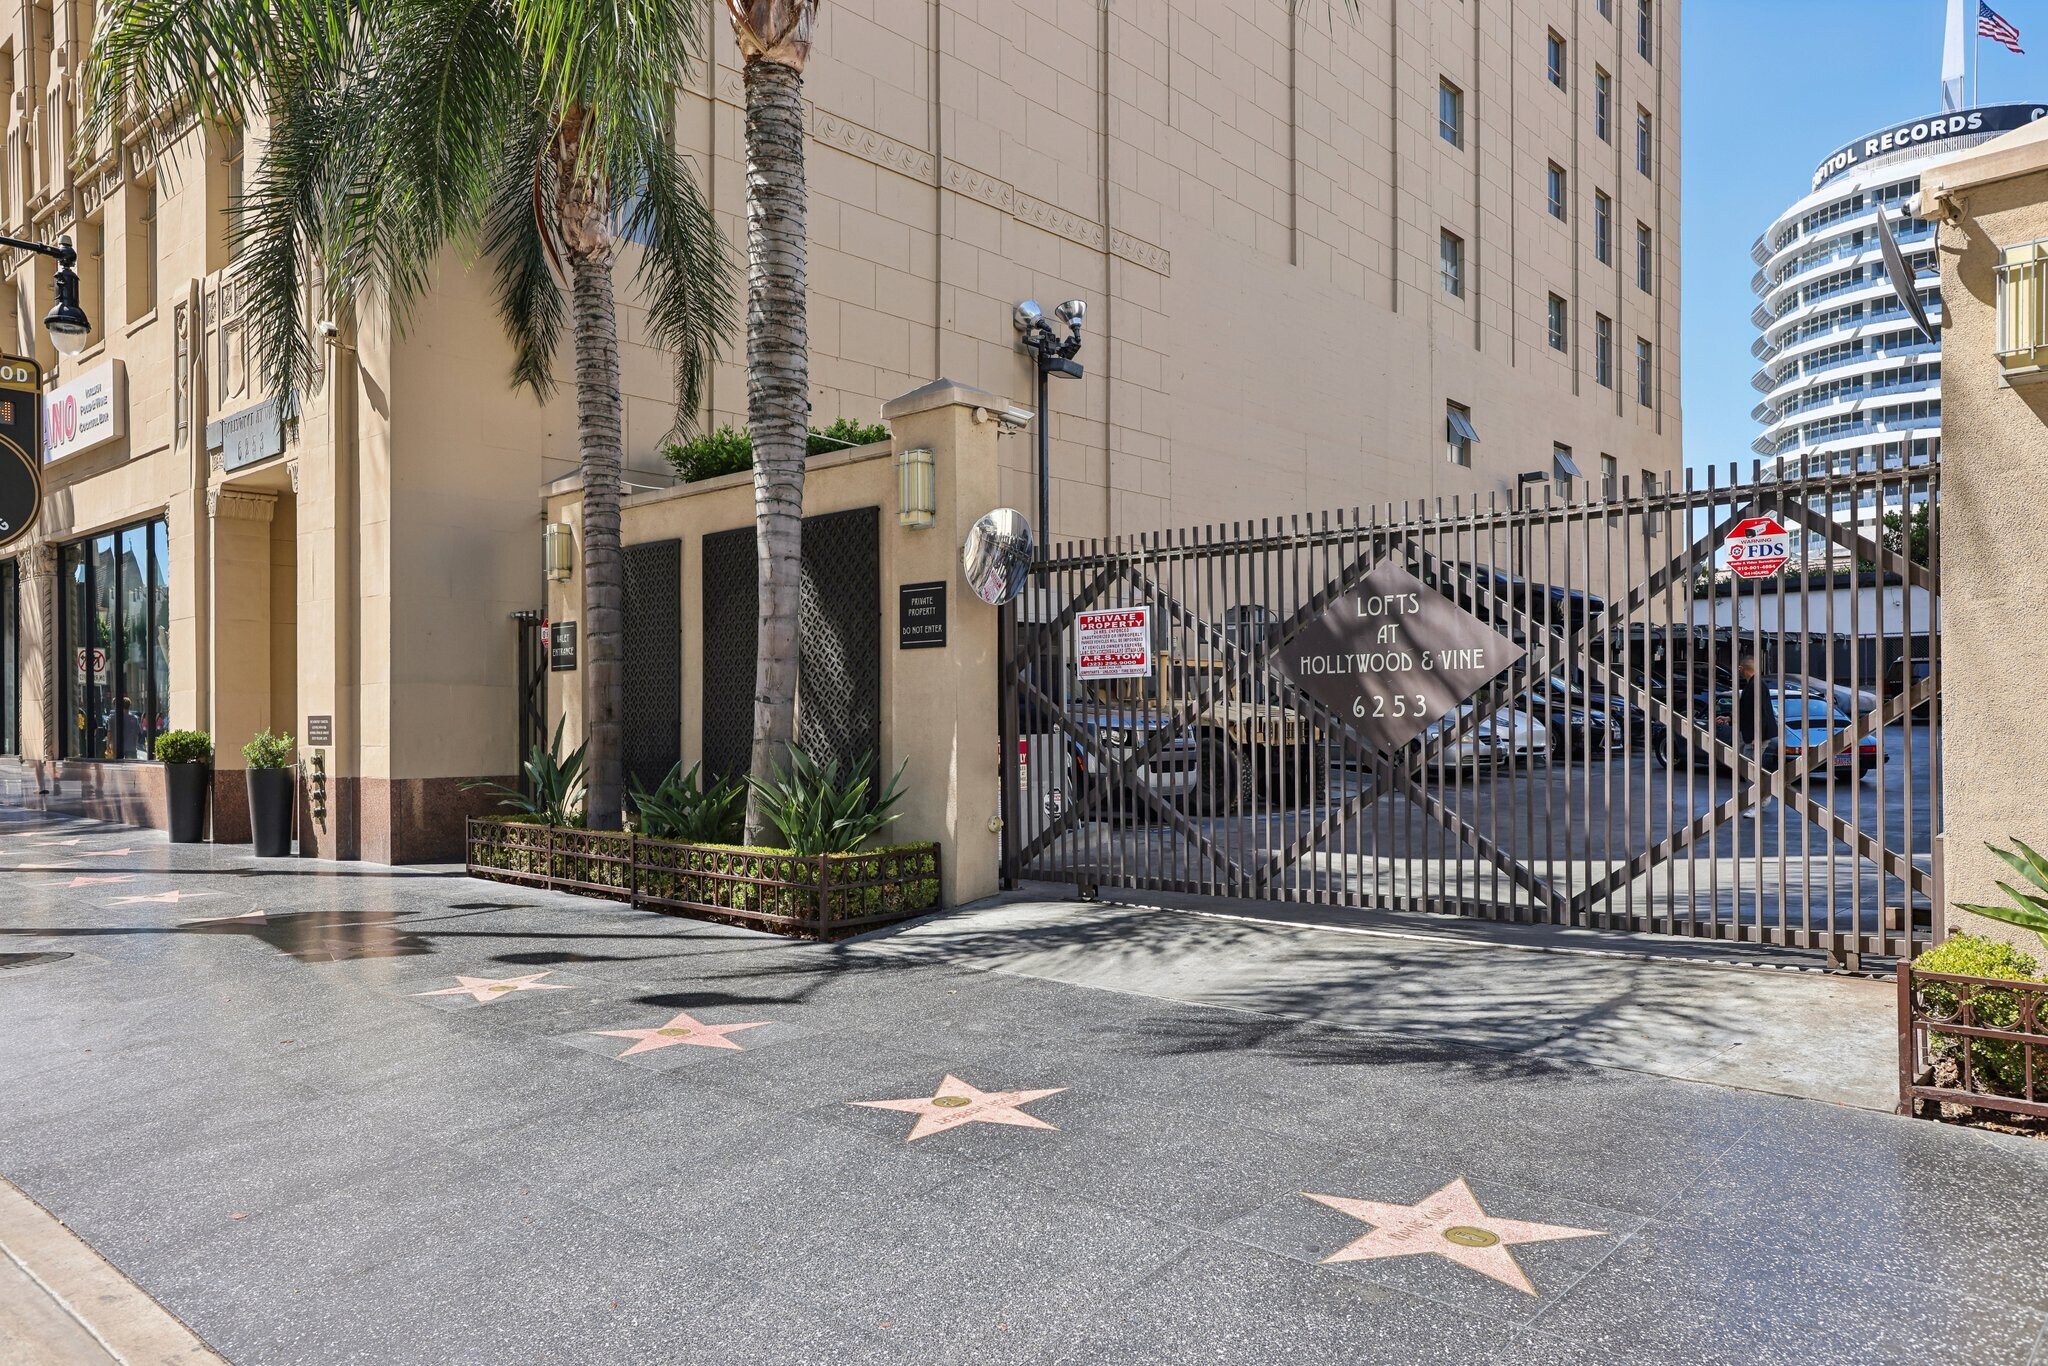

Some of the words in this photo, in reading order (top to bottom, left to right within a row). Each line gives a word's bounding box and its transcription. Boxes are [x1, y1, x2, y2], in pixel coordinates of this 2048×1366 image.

[1865, 112, 1983, 157] RECORDS
[1748, 543, 1784, 558] FDS
[911, 596, 933, 606] PRIVATE
[1357, 593, 1420, 617] LOFTS
[908, 607, 936, 617] PROPERTY
[1087, 613, 1136, 623] PRIVATE
[902, 626, 911, 635] DO
[912, 625, 923, 634] NOT
[925, 624, 943, 633] ENTER
[1081, 619, 1143, 630] PROPERTY
[1377, 624, 1399, 644] AT
[552, 646, 574, 657] ENTRANCE
[1300, 651, 1413, 675] HOLLYWOOD
[1421, 651, 1434, 671] &
[1441, 649, 1485, 670] VINE
[1353, 695, 1427, 718] 6253
